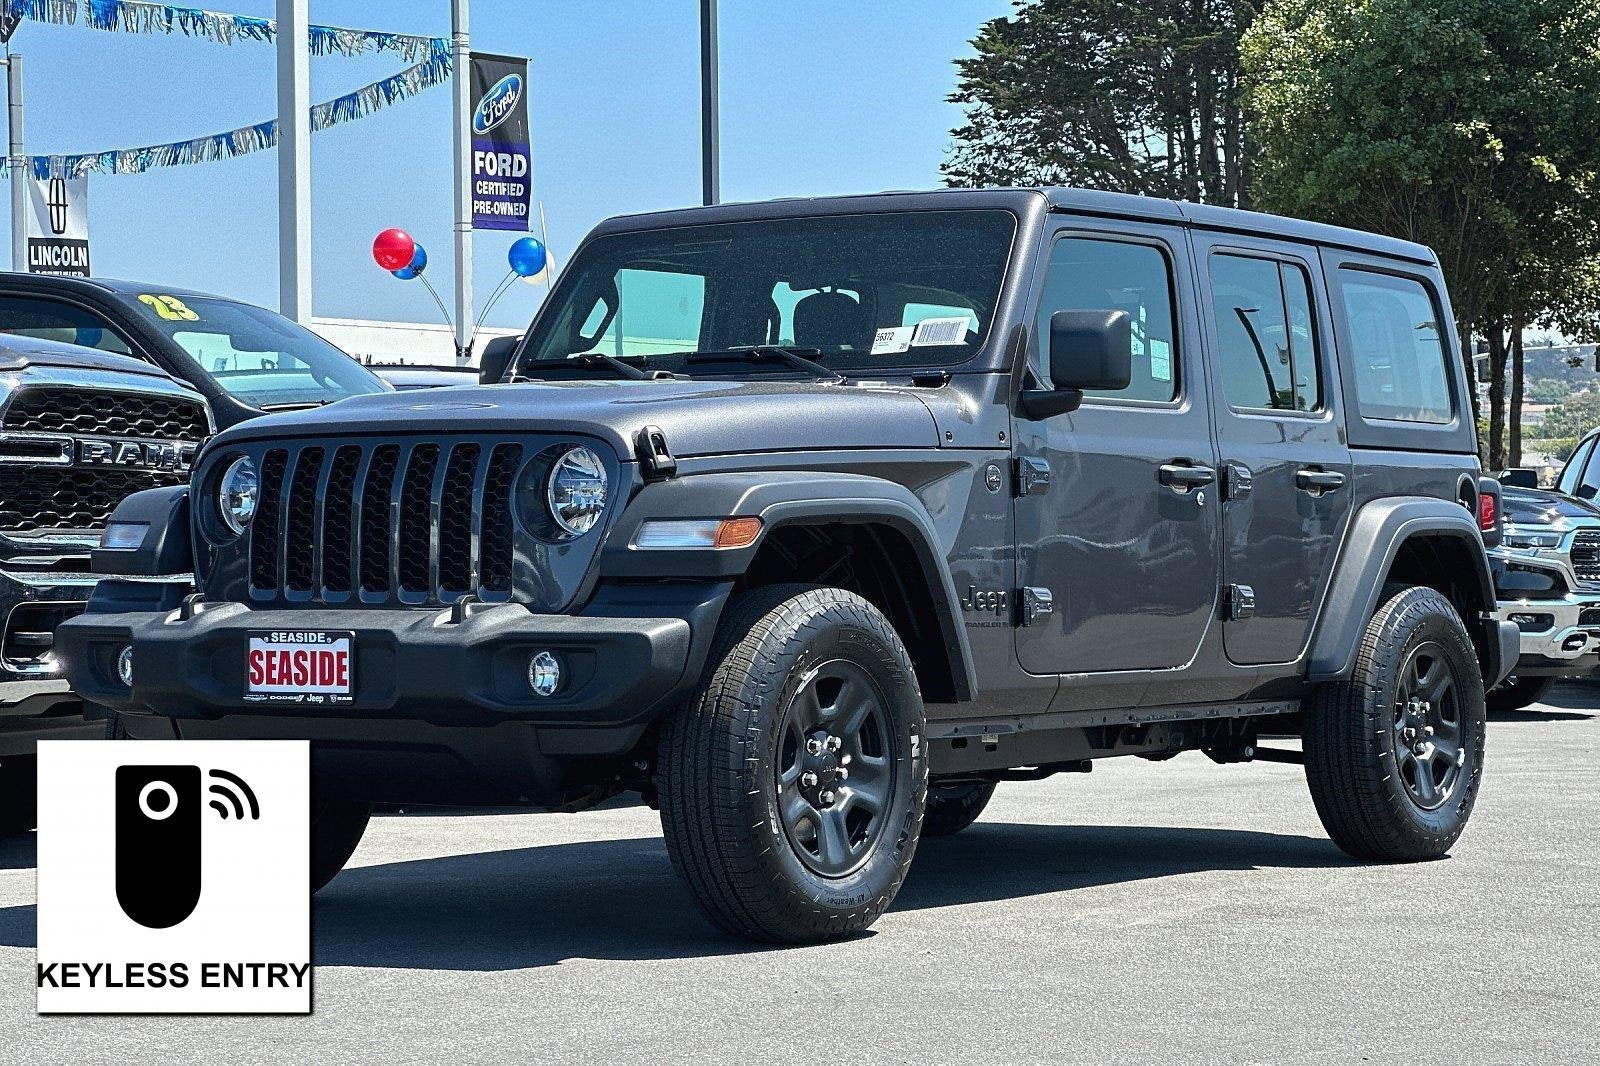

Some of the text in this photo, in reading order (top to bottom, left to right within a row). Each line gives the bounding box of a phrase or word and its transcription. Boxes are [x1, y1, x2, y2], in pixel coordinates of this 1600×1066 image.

[482, 83, 516, 127] Ford
[474, 151, 527, 177] FORD
[476, 180, 525, 197] CERTIFIED
[473, 200, 527, 217] PRE-OWNED
[30, 245, 88, 267] LINCOLN
[137, 294, 200, 322] 23
[81, 441, 174, 467] RAM
[961, 584, 1008, 616] Jeep
[271, 632, 326, 643] SEASIDE
[249, 650, 348, 686] SEASIDE
[306, 693, 324, 703] Jeep
